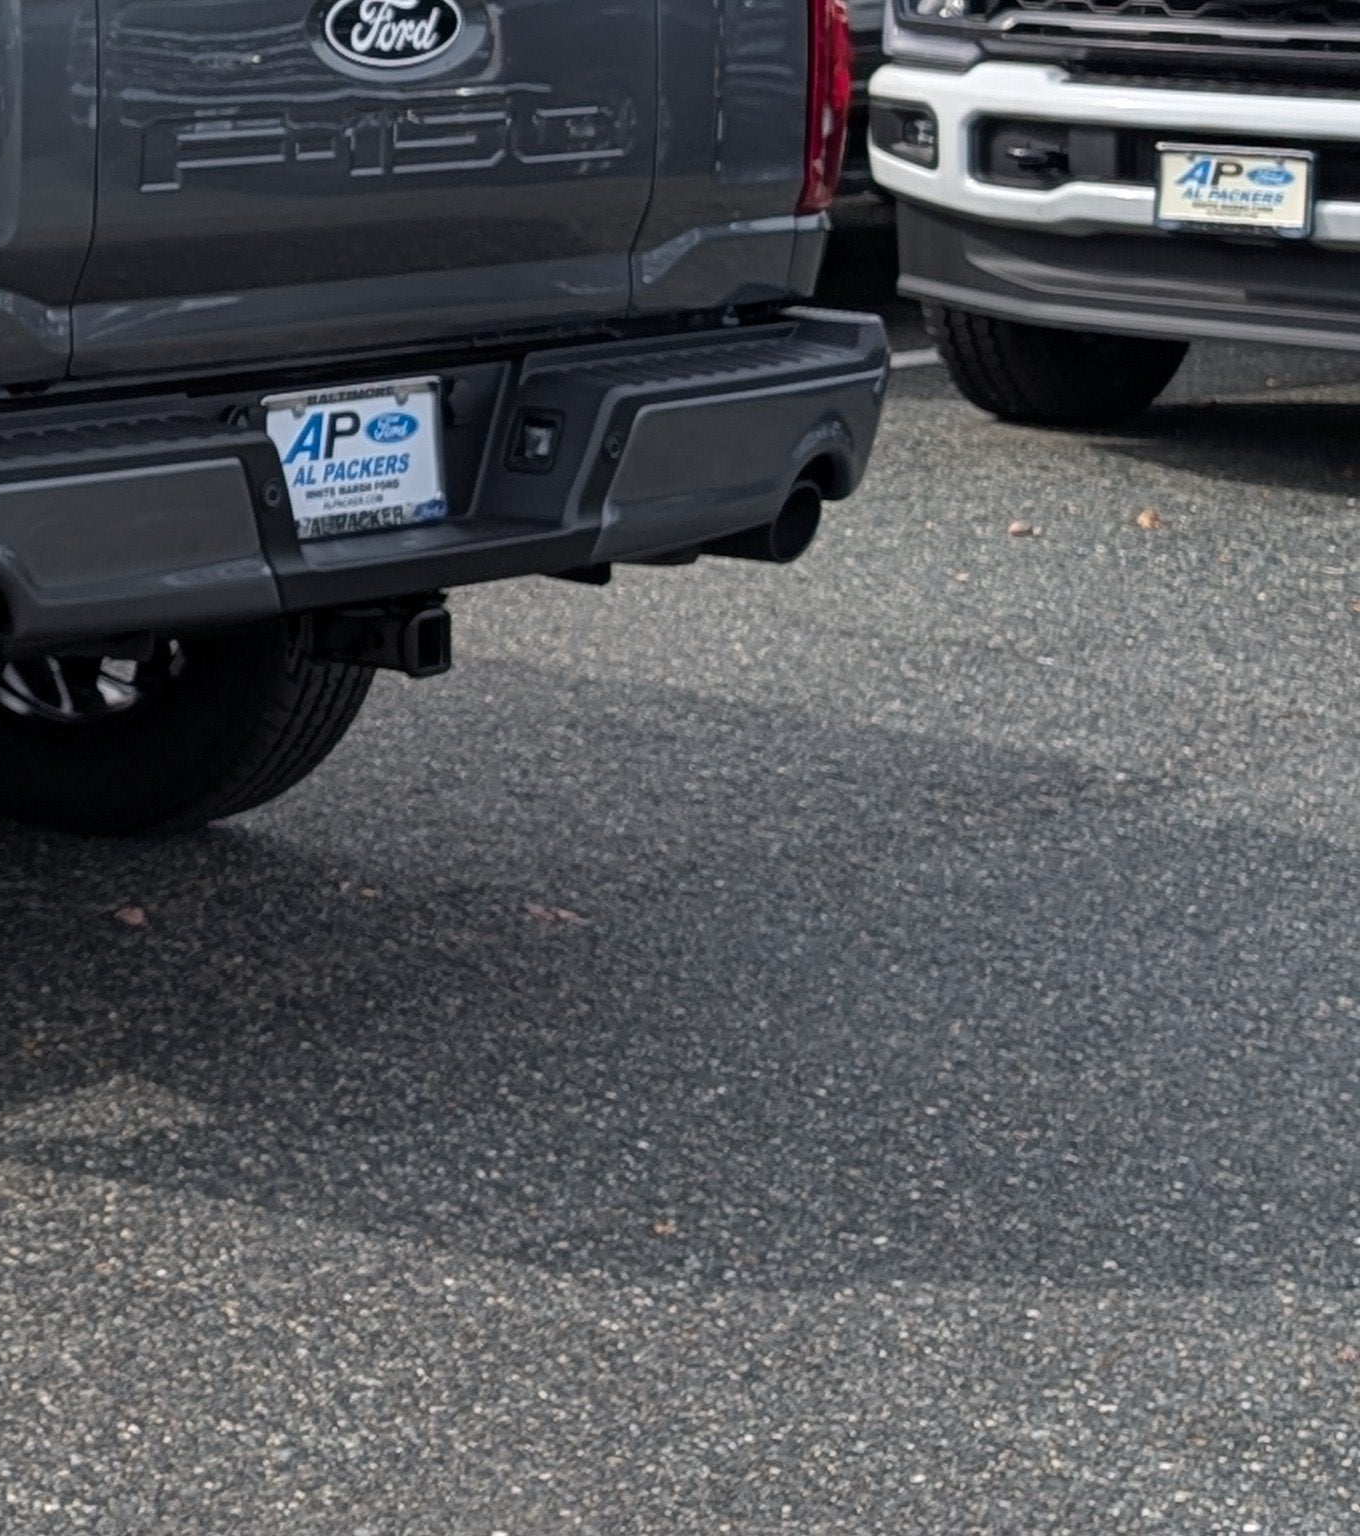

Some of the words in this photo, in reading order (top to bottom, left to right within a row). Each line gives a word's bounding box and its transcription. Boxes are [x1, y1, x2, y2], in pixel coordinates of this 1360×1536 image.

[1175, 157, 1244, 186] AP
[1182, 187, 1202, 200] AL
[1208, 188, 1284, 205] PACKERS
[284, 412, 360, 464] AP
[293, 466, 316, 487] AL
[323, 453, 410, 482] PACKERS
